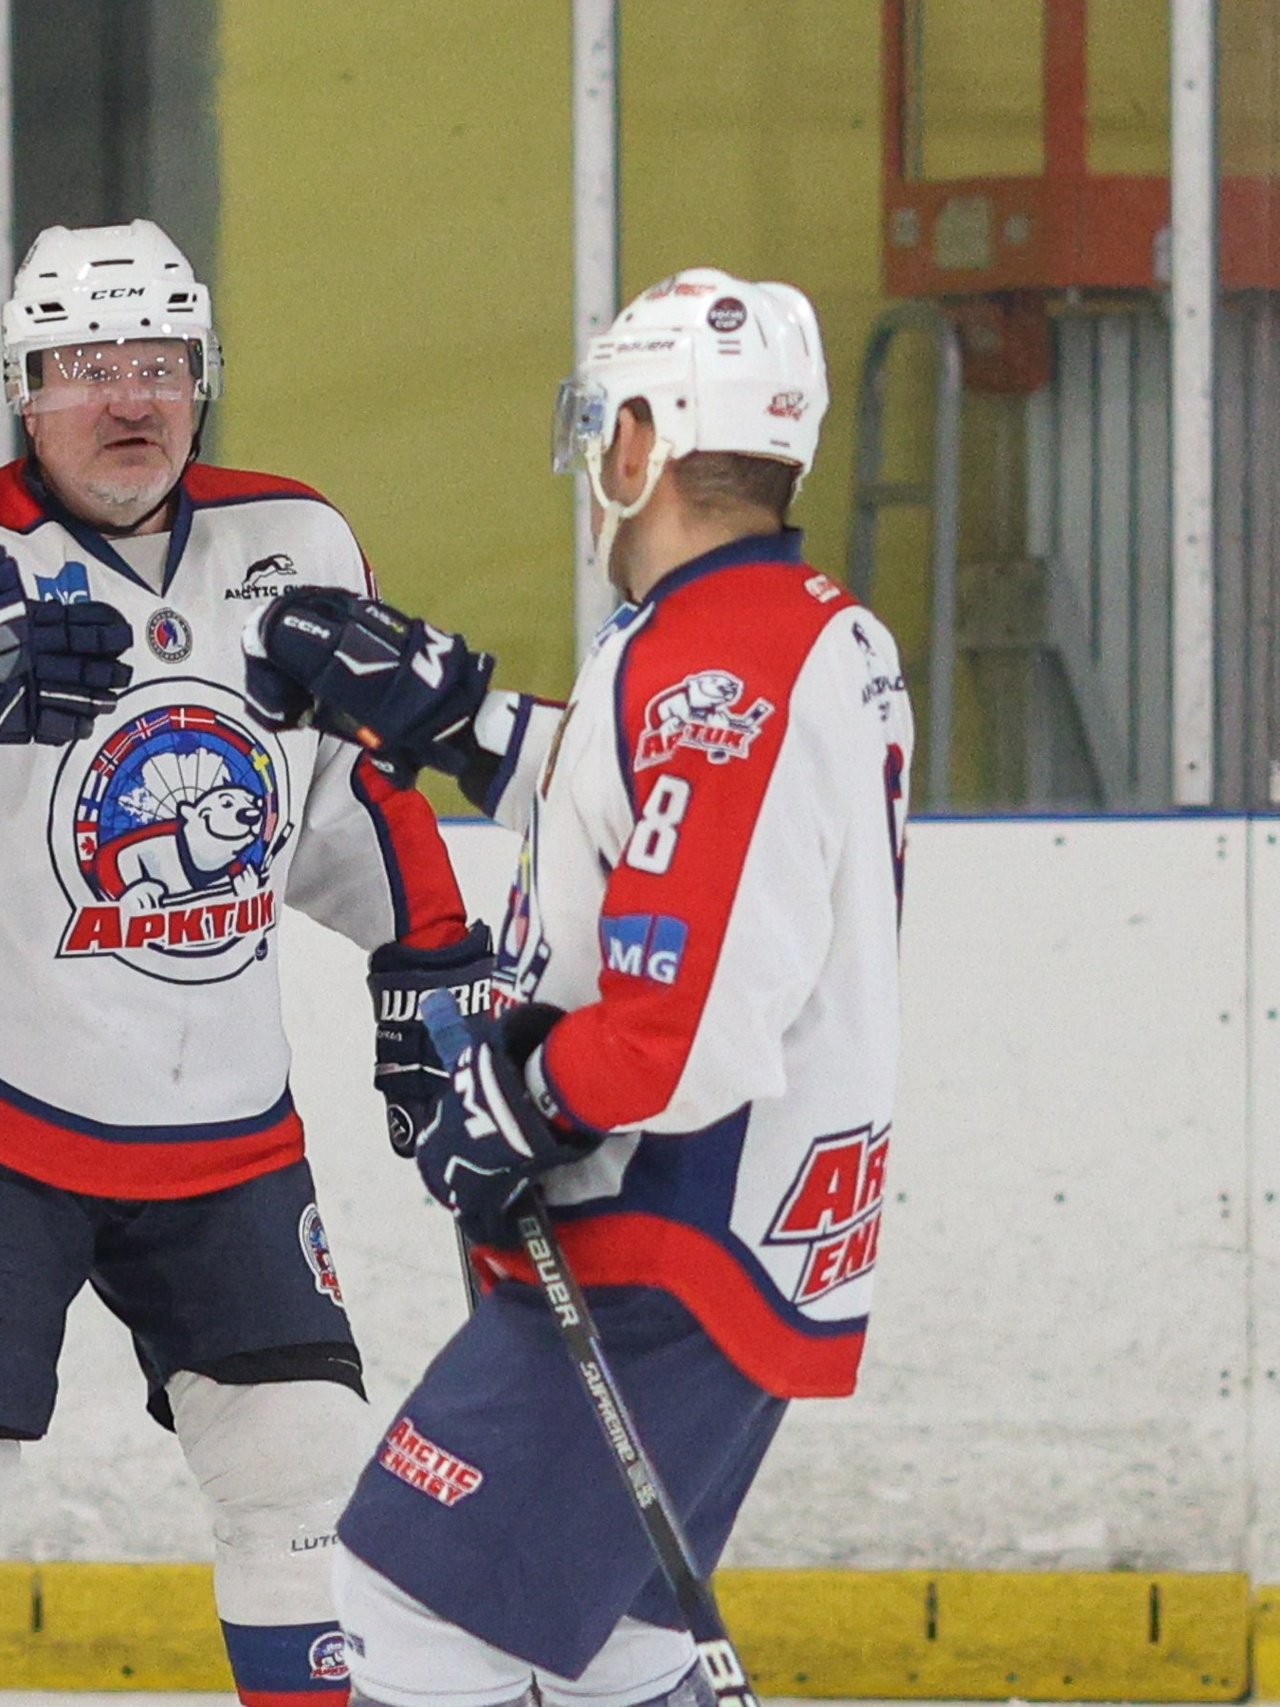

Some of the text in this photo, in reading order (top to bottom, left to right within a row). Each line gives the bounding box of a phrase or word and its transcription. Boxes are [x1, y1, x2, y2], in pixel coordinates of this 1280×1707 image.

[91, 286, 145, 300] CCM
[625, 774, 691, 875] 8
[380, 1448, 463, 1502] ENERGY
[389, 1422, 479, 1489] ARCTIC
